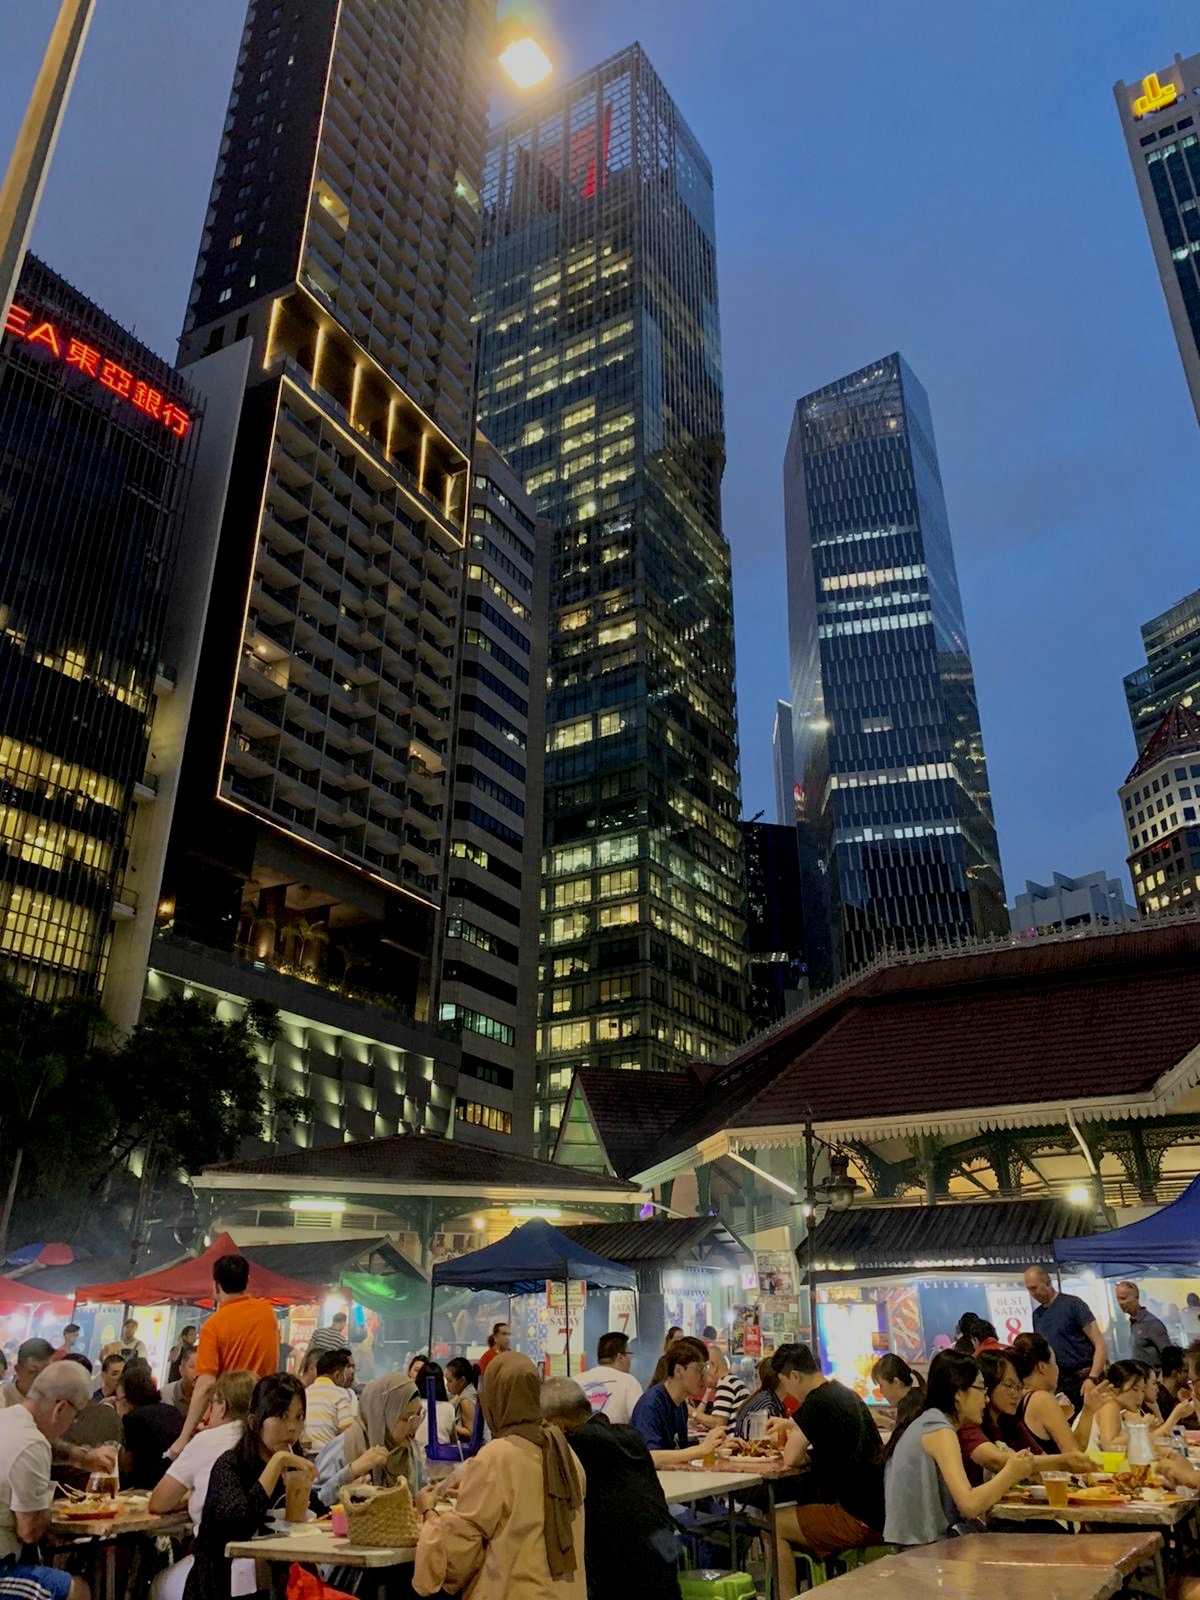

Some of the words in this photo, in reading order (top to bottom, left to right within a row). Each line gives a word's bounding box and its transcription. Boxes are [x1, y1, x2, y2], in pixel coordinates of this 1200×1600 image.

[65, 337, 191, 437] 東亞銀行
[614, 1295, 633, 1303] BEST
[996, 1297, 1023, 1306] BEST
[994, 1307, 1028, 1316] SATAY
[616, 1312, 630, 1333] 7
[1005, 1317, 1022, 1345] 8
[557, 1328, 573, 1355] 7
